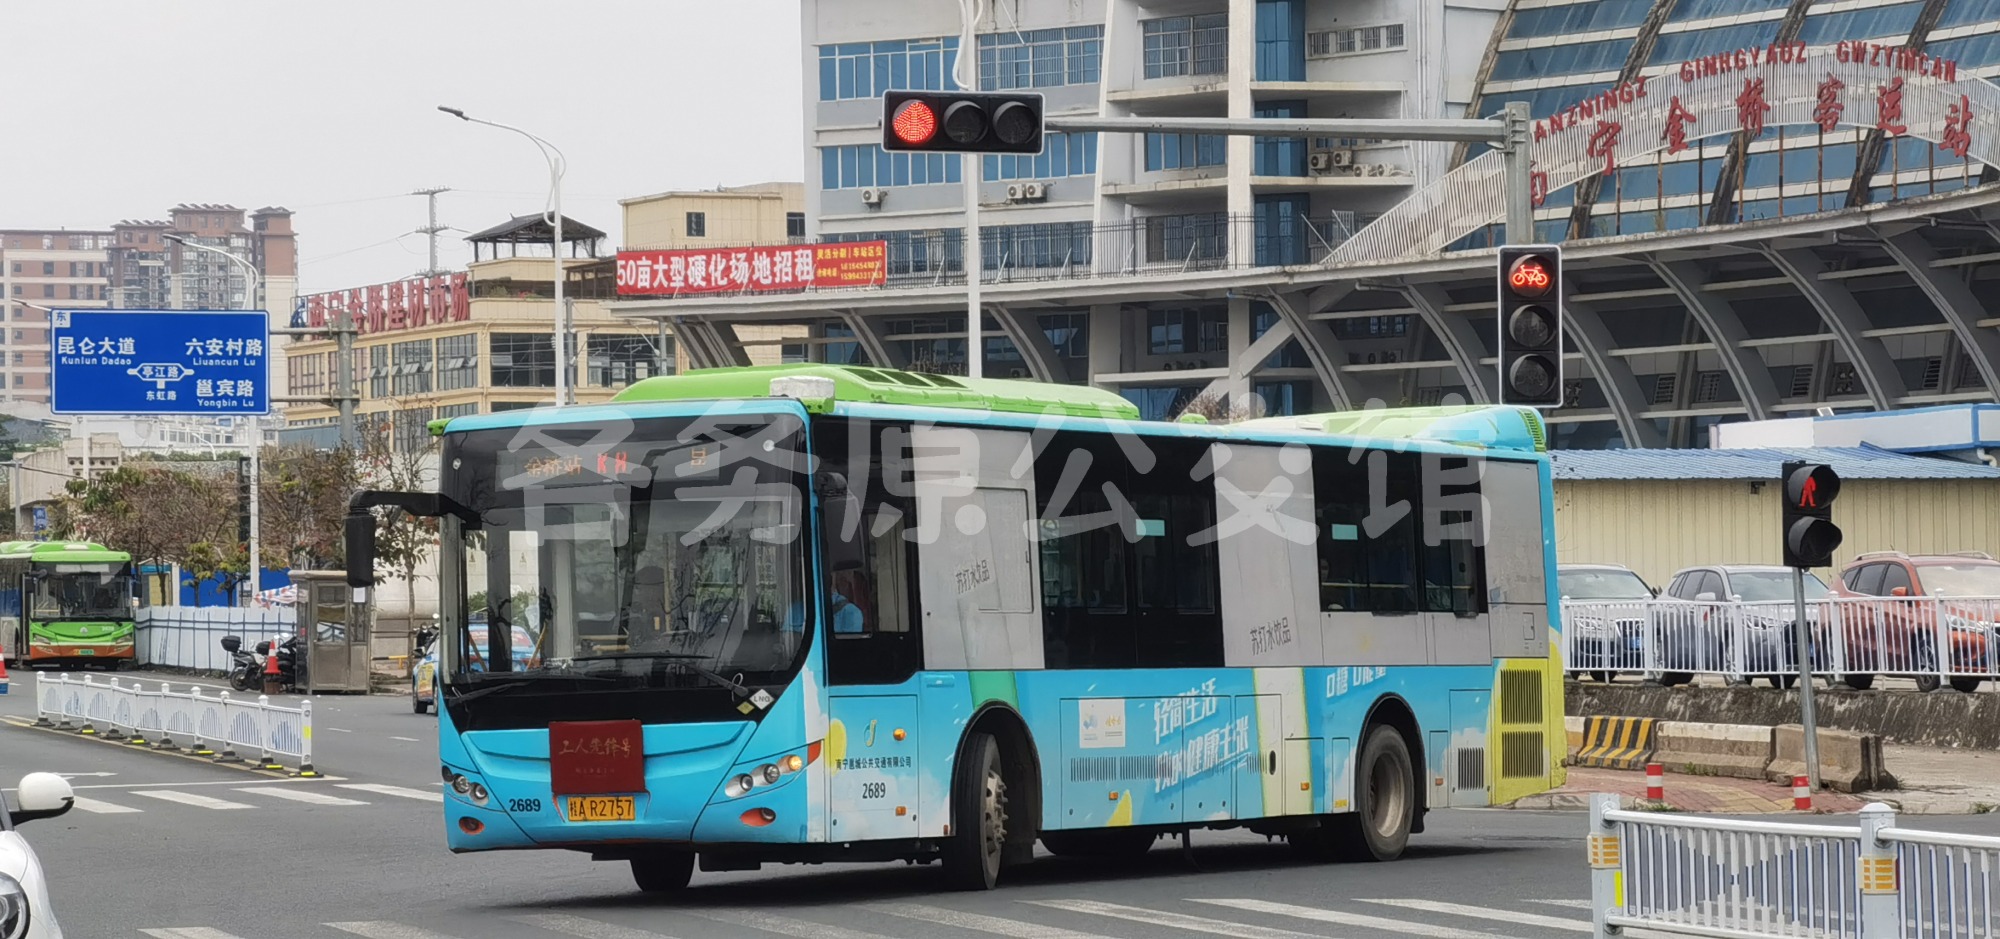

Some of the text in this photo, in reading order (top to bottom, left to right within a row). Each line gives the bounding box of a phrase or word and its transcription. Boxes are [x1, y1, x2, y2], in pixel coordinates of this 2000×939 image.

[1533, 76, 1648, 144] ANZNINGZ
[617, 248, 814, 290] 50亩大型硬化场地招租
[55, 311, 66, 322] 东
[57, 337, 136, 355] 昆仑大道
[185, 338, 263, 356] 六安村路
[61, 356, 132, 365] Kunlun Dadao
[193, 357, 256, 366] Liuancun Lu
[142, 366, 179, 378] 亭江路
[146, 391, 177, 401] 东虹路
[196, 379, 254, 397] 邕宾路
[197, 398, 255, 409] Yongbin Lu
[955, 559, 990, 594] 苏打水饮品
[1250, 617, 1291, 655] 苏打水饮品
[1154, 678, 1217, 745] 轻简生活
[559, 738, 631, 758] 工人先锋号
[835, 756, 912, 770] 南宁邕城公共交通有限公司
[862, 782, 886, 799] 2689
[508, 799, 542, 812] 2689
